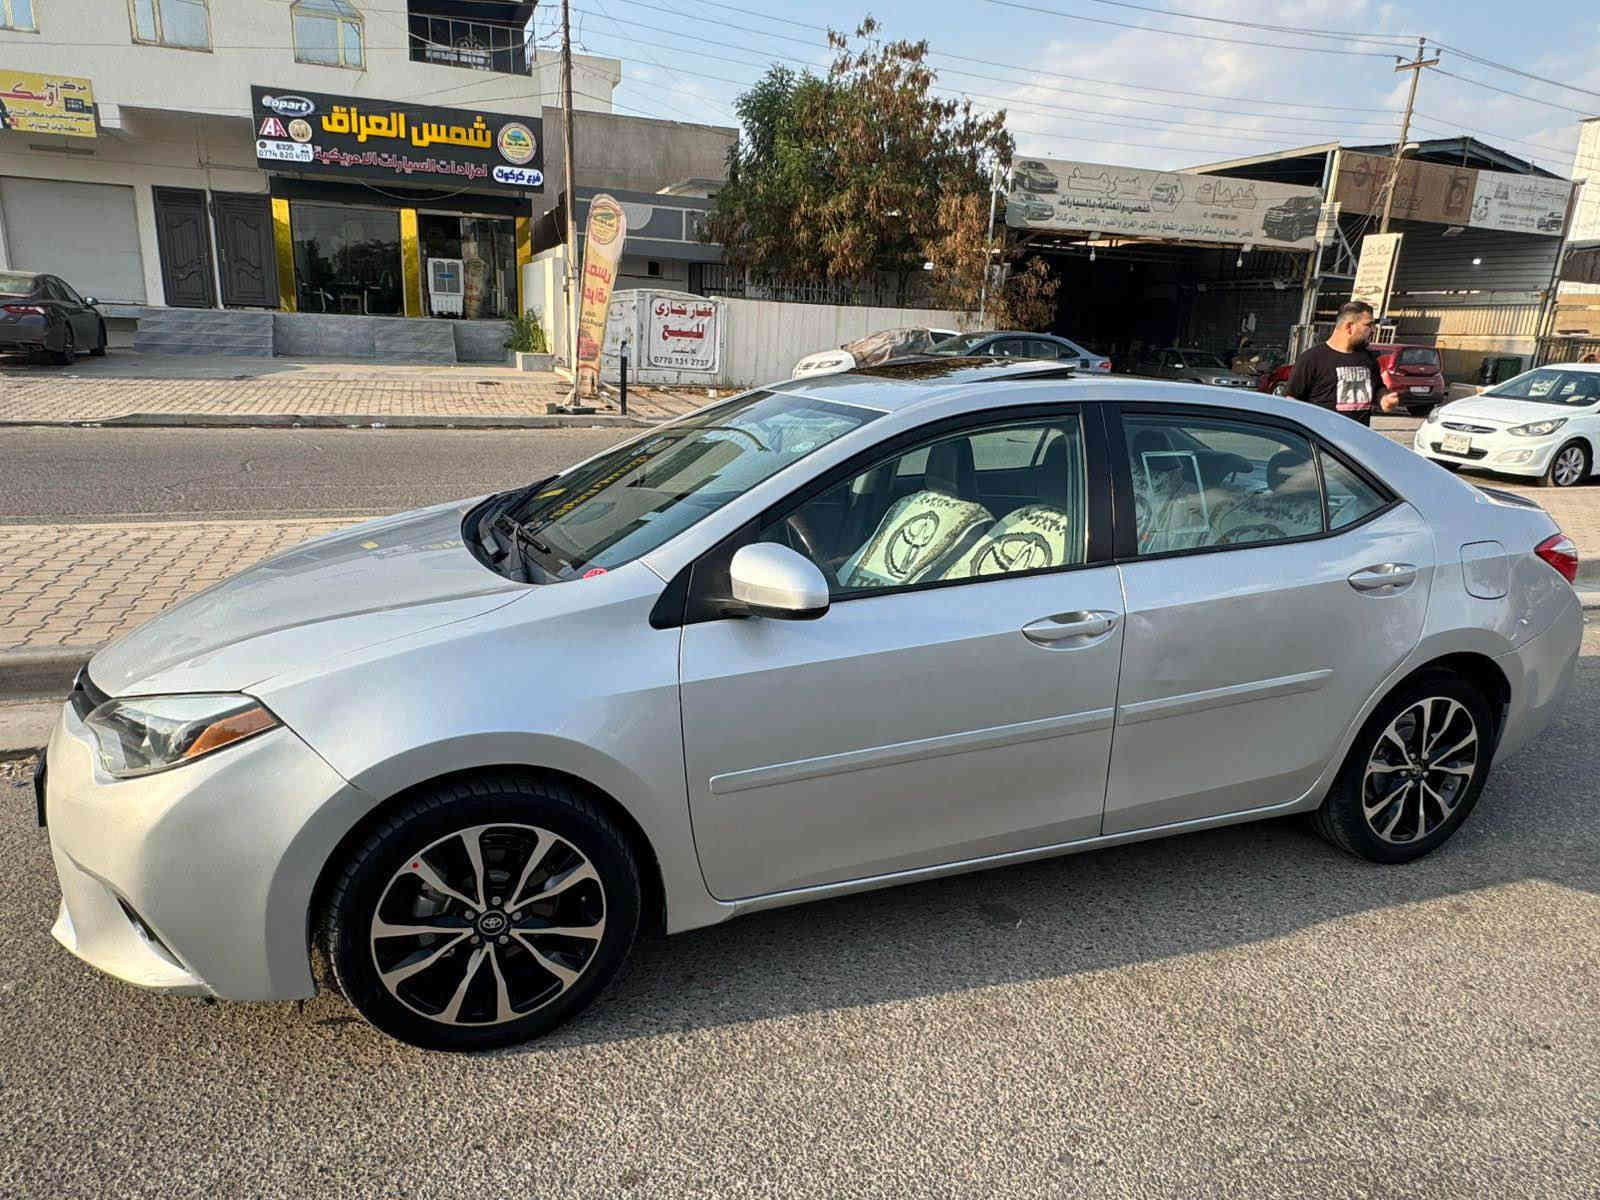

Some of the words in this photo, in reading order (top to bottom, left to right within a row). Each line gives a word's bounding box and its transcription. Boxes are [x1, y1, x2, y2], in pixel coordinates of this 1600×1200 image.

[321, 105, 406, 142] العراق
[411, 115, 492, 149] شمس
[495, 167, 525, 181] كركوك
[655, 301, 687, 318] تجاري
[662, 323, 705, 342] للبيع
